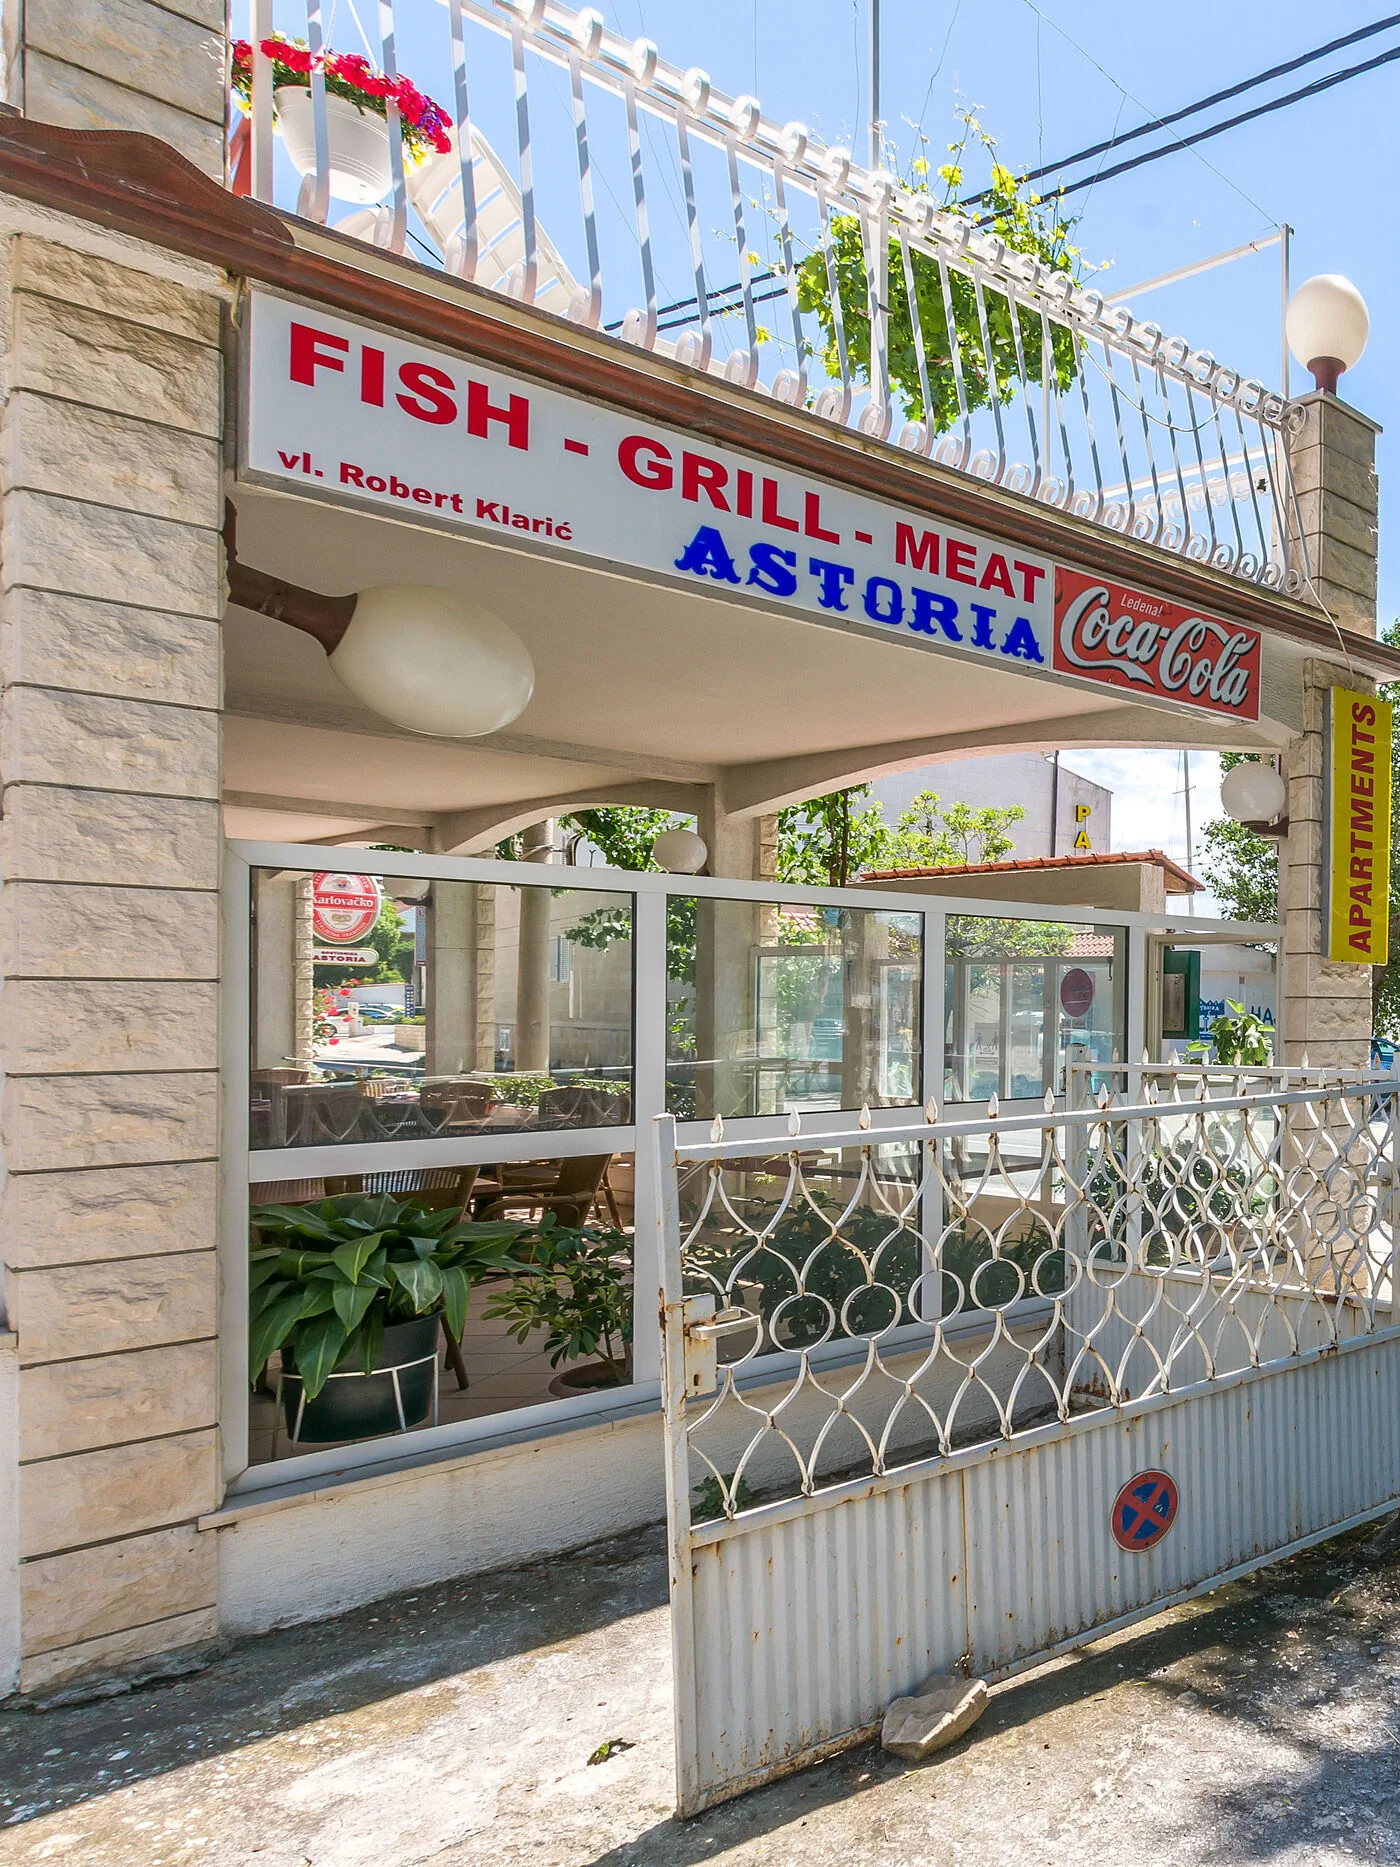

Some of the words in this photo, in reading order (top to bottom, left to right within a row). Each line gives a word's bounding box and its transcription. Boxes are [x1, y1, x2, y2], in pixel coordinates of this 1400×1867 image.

[277, 450, 325, 478] vl.
[339, 461, 464, 513] Robert
[476, 498, 574, 541] Klarić
[289, 321, 530, 451] FISH
[617, 434, 841, 545] GRILL
[894, 521, 1046, 605] MEAT
[673, 525, 1046, 664] ASTORIA
[1059, 585, 1258, 707] Coca-Cola
[1120, 593, 1164, 618] Ledena!
[1348, 702, 1377, 954] APARTMENTS
[312, 954, 366, 963] ASTORIA
